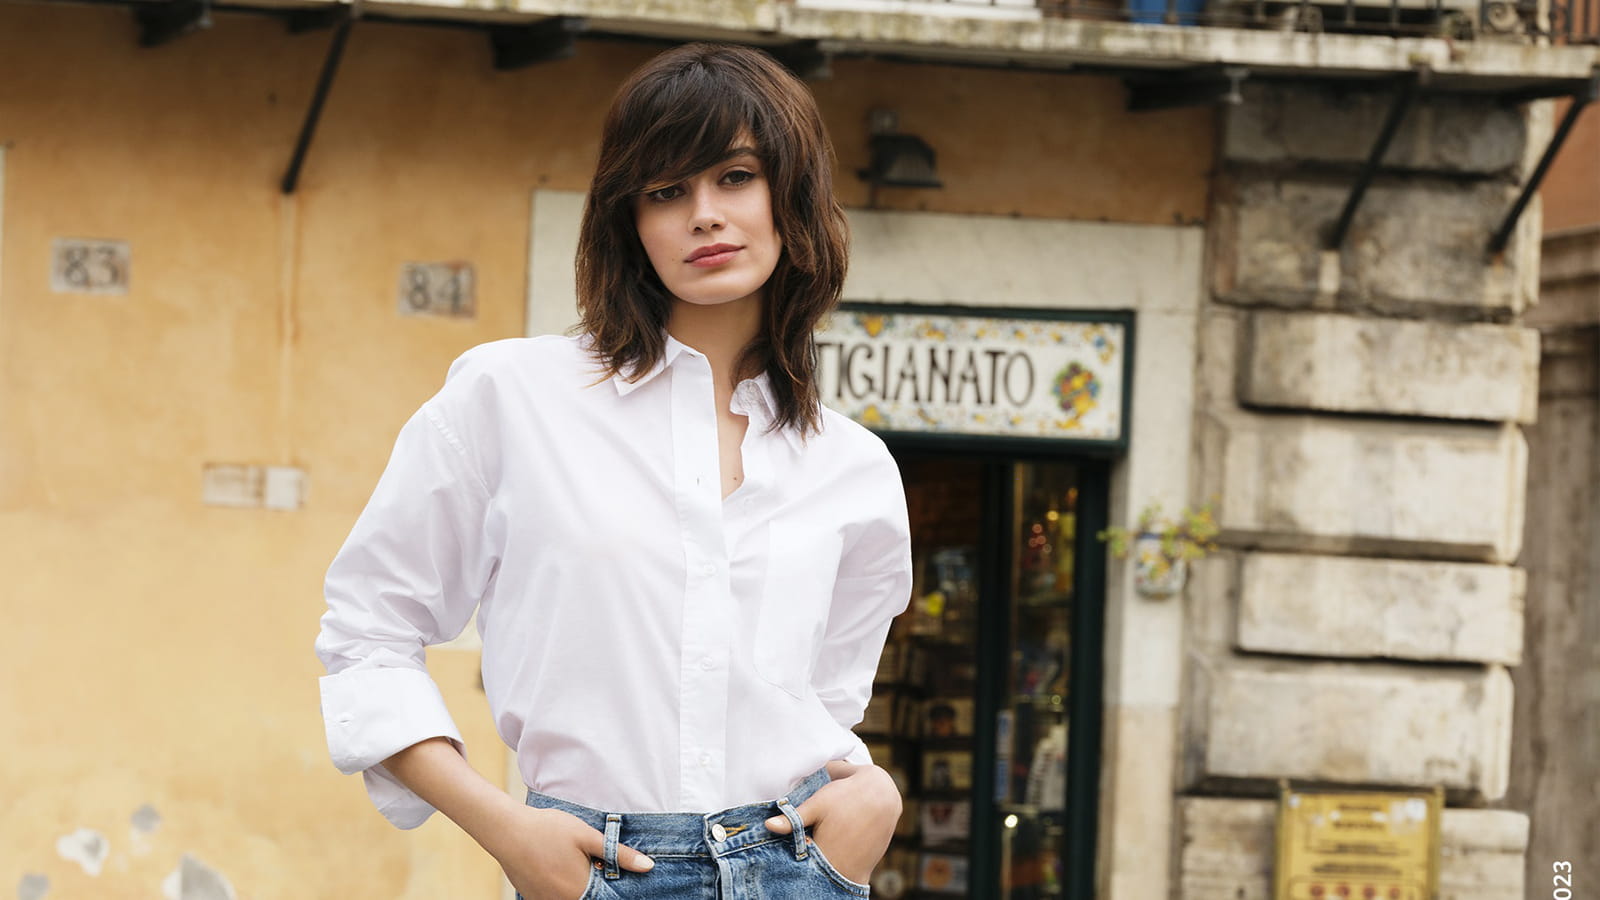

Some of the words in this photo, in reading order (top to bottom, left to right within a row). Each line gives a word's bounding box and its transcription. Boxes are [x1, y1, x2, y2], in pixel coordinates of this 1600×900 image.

[64, 246, 119, 288] 83
[408, 266, 466, 313] 84
[816, 341, 1034, 406] TIGIANATO
